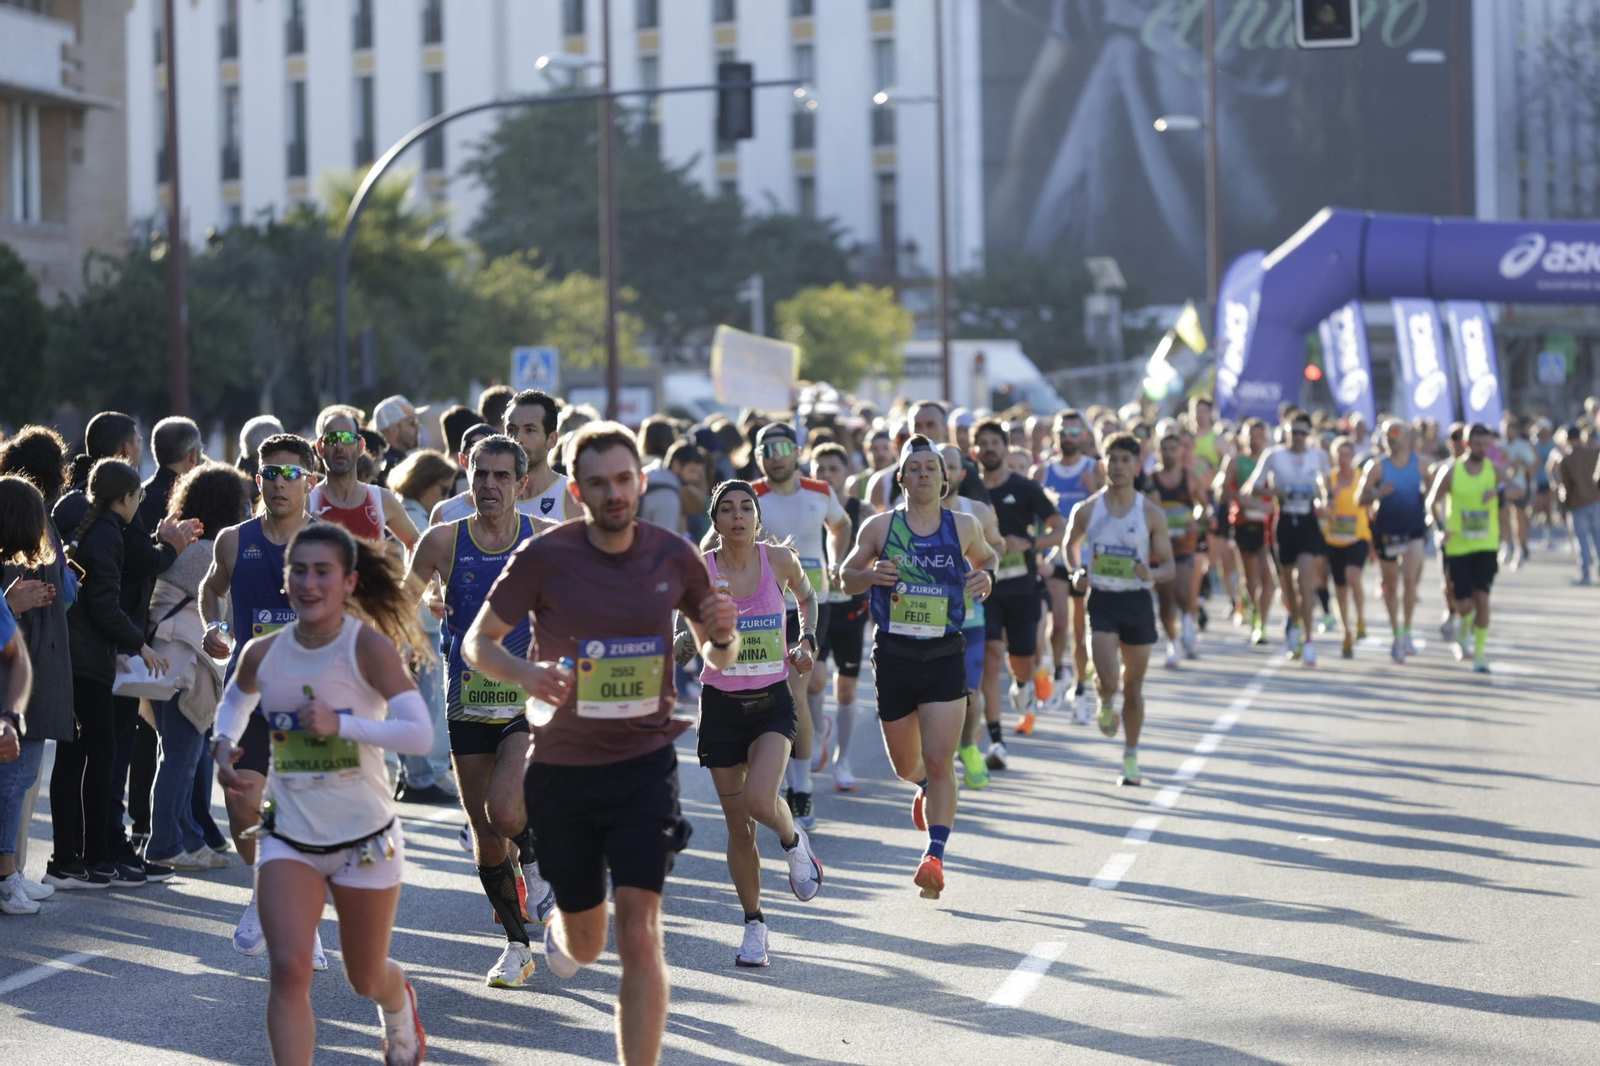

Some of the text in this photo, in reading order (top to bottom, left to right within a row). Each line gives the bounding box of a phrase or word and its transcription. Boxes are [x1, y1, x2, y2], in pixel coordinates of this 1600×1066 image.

[894, 554, 955, 568] RUNNEA
[910, 585, 943, 595] ZURICH
[910, 601, 927, 609] 2146
[904, 610, 931, 623] FEDE
[740, 618, 776, 629] ZURICH
[742, 637, 761, 645] 1484
[609, 641, 656, 656] ZURICH
[601, 680, 645, 698] OLLIE
[468, 690, 518, 704] GIORGIO
